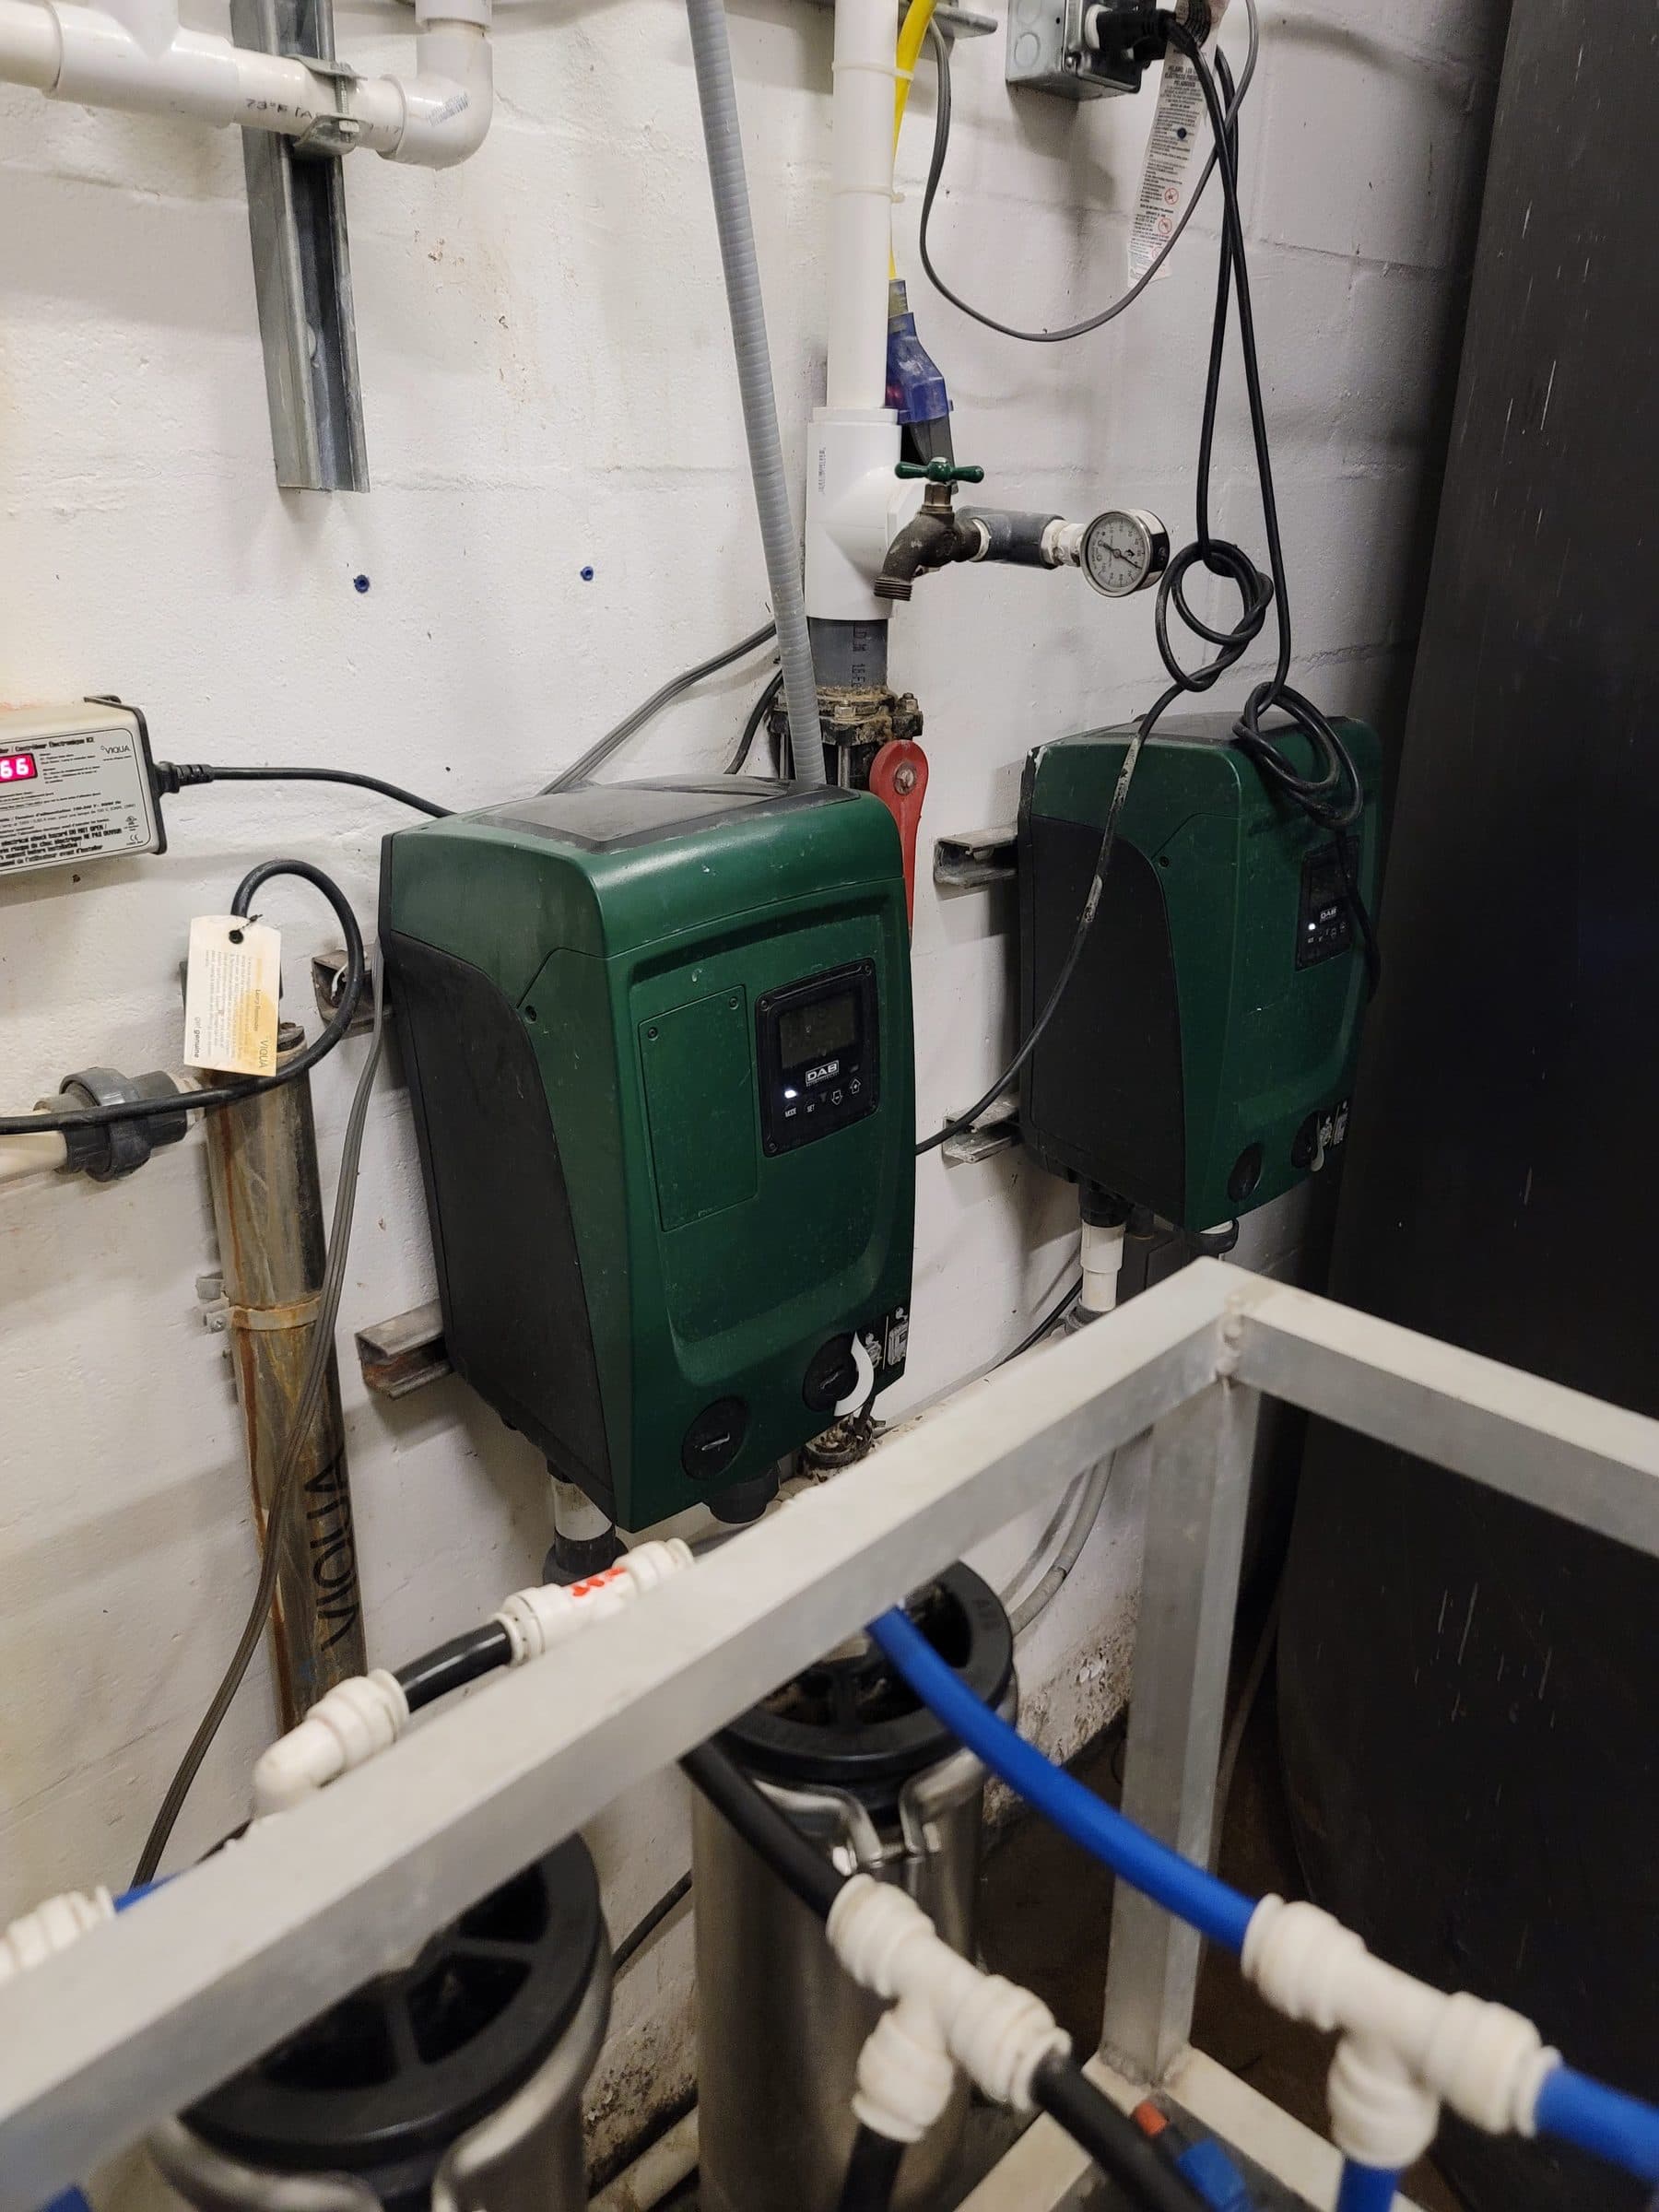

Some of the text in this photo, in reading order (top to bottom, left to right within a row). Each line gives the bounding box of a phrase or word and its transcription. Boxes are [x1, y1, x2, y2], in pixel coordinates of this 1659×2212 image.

[106, 745, 131, 754] VIQUA
[258, 1040, 269, 1068] VIQUA
[807, 1063, 838, 1081] DAB
